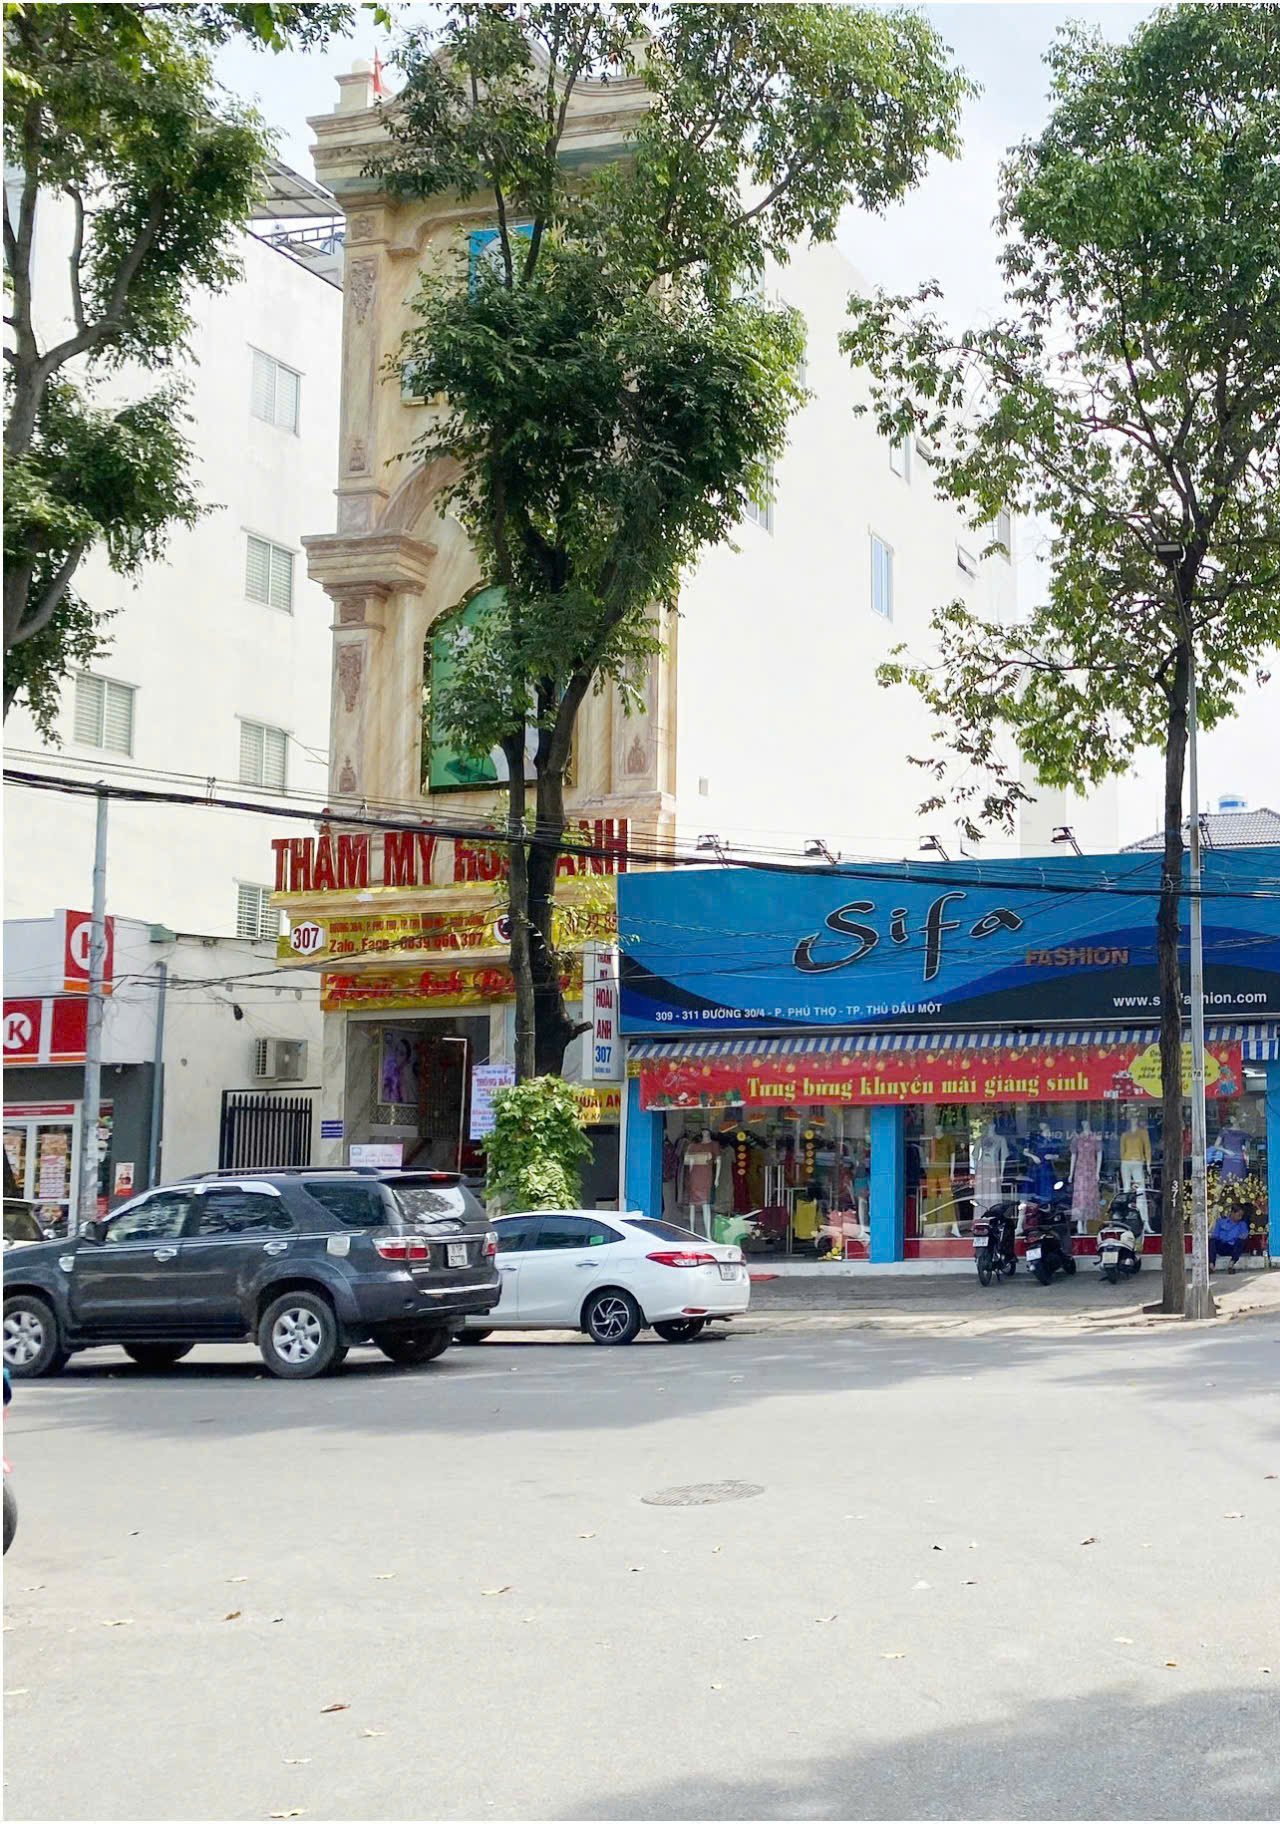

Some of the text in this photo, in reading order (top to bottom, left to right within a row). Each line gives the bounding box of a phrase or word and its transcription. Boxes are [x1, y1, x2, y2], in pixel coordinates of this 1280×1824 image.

[271, 807, 369, 893] THẨM
[384, 820, 438, 886] MỸ
[293, 927, 320, 949] 307
[793, 892, 1023, 981] Sifa
[1025, 946, 1129, 967] FASHION
[655, 1011, 674, 1022] 309
[682, 1010, 700, 1020] 311
[702, 1006, 743, 1020] ĐƯỜNG
[744, 1008, 766, 1019] 30/4
[775, 1007, 786, 1018] P.
[846, 1005, 863, 1017] TP.
[917, 1001, 943, 1016] MỘT
[9, 1021, 26, 1045] K
[597, 1018, 612, 1040] ANH
[595, 1045, 612, 1063] 307
[1046, 1071, 1090, 1092] sinh
